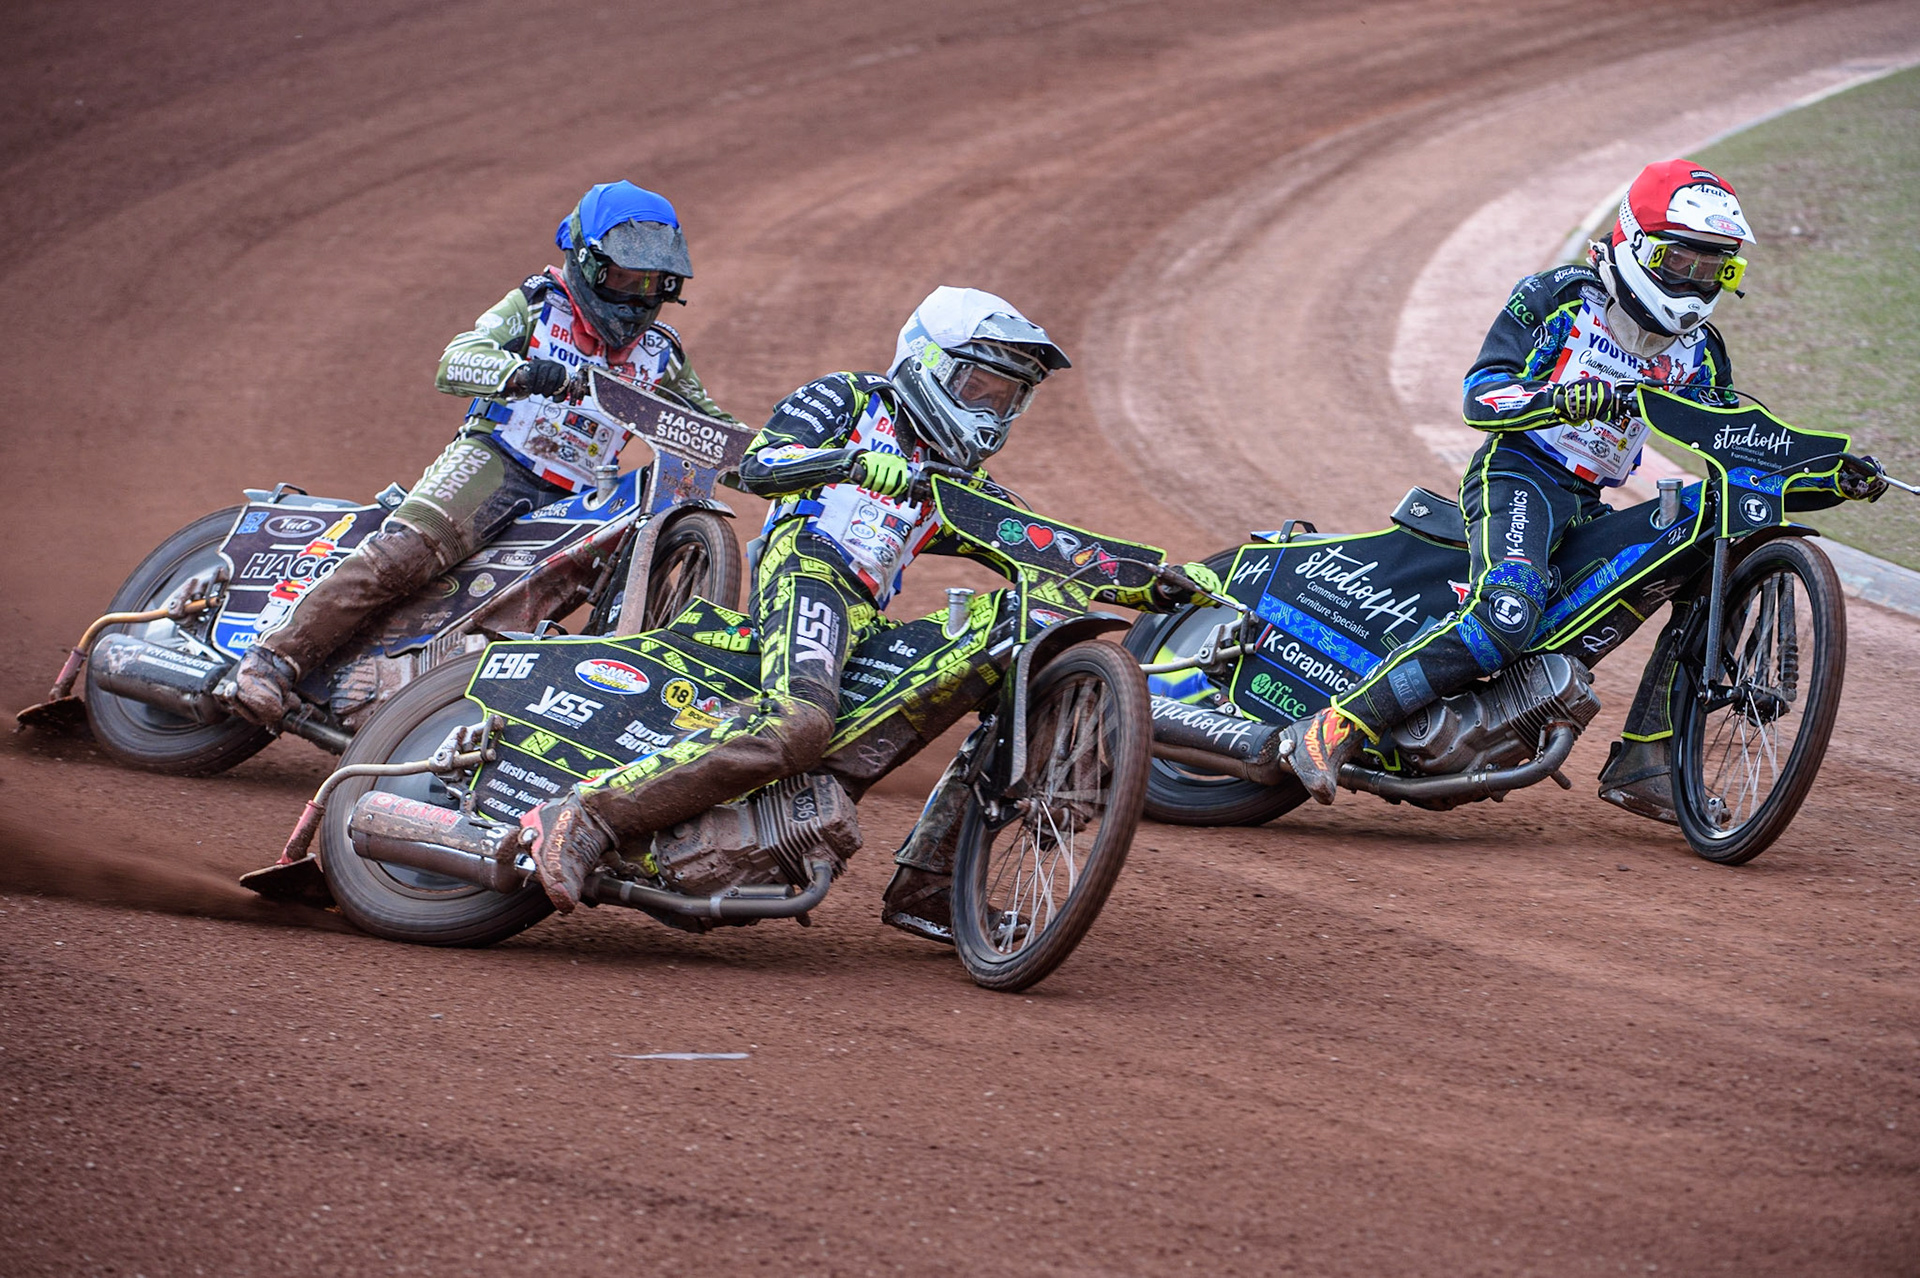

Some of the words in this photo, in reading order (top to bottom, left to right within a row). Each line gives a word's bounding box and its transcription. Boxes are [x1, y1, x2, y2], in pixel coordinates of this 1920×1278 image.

[1695, 184, 1726, 198] Arai
[1509, 292, 1534, 325] fice
[448, 350, 509, 370] HAGON
[1589, 332, 1638, 370] YOUTH
[446, 365, 500, 385] SHOCKS
[656, 423, 724, 459] SHOCKS
[657, 410, 729, 447] HAGON
[1713, 423, 1795, 456] studio44
[1731, 444, 1764, 457] Commercial
[1731, 452, 1757, 463] Furniture
[418, 444, 474, 496] HAGON
[434, 448, 492, 502] SHOCKS
[1505, 490, 1530, 557] K-Graphics
[240, 552, 342, 580] HAGO
[1232, 554, 1272, 585] 44
[1294, 545, 1421, 634] studio44
[1306, 580, 1353, 610] Commercial
[1296, 592, 1332, 619] Furniture
[1330, 611, 1370, 640] Specialist
[888, 639, 917, 658] Jac
[479, 653, 540, 679] 696
[594, 663, 638, 684] SMR
[525, 685, 604, 723] YSS
[671, 685, 689, 703] 18
[1150, 695, 1253, 750] studio44
[486, 778, 516, 797] Mike
[497, 760, 527, 781] Kirsty
[524, 771, 560, 794] Caffrey
